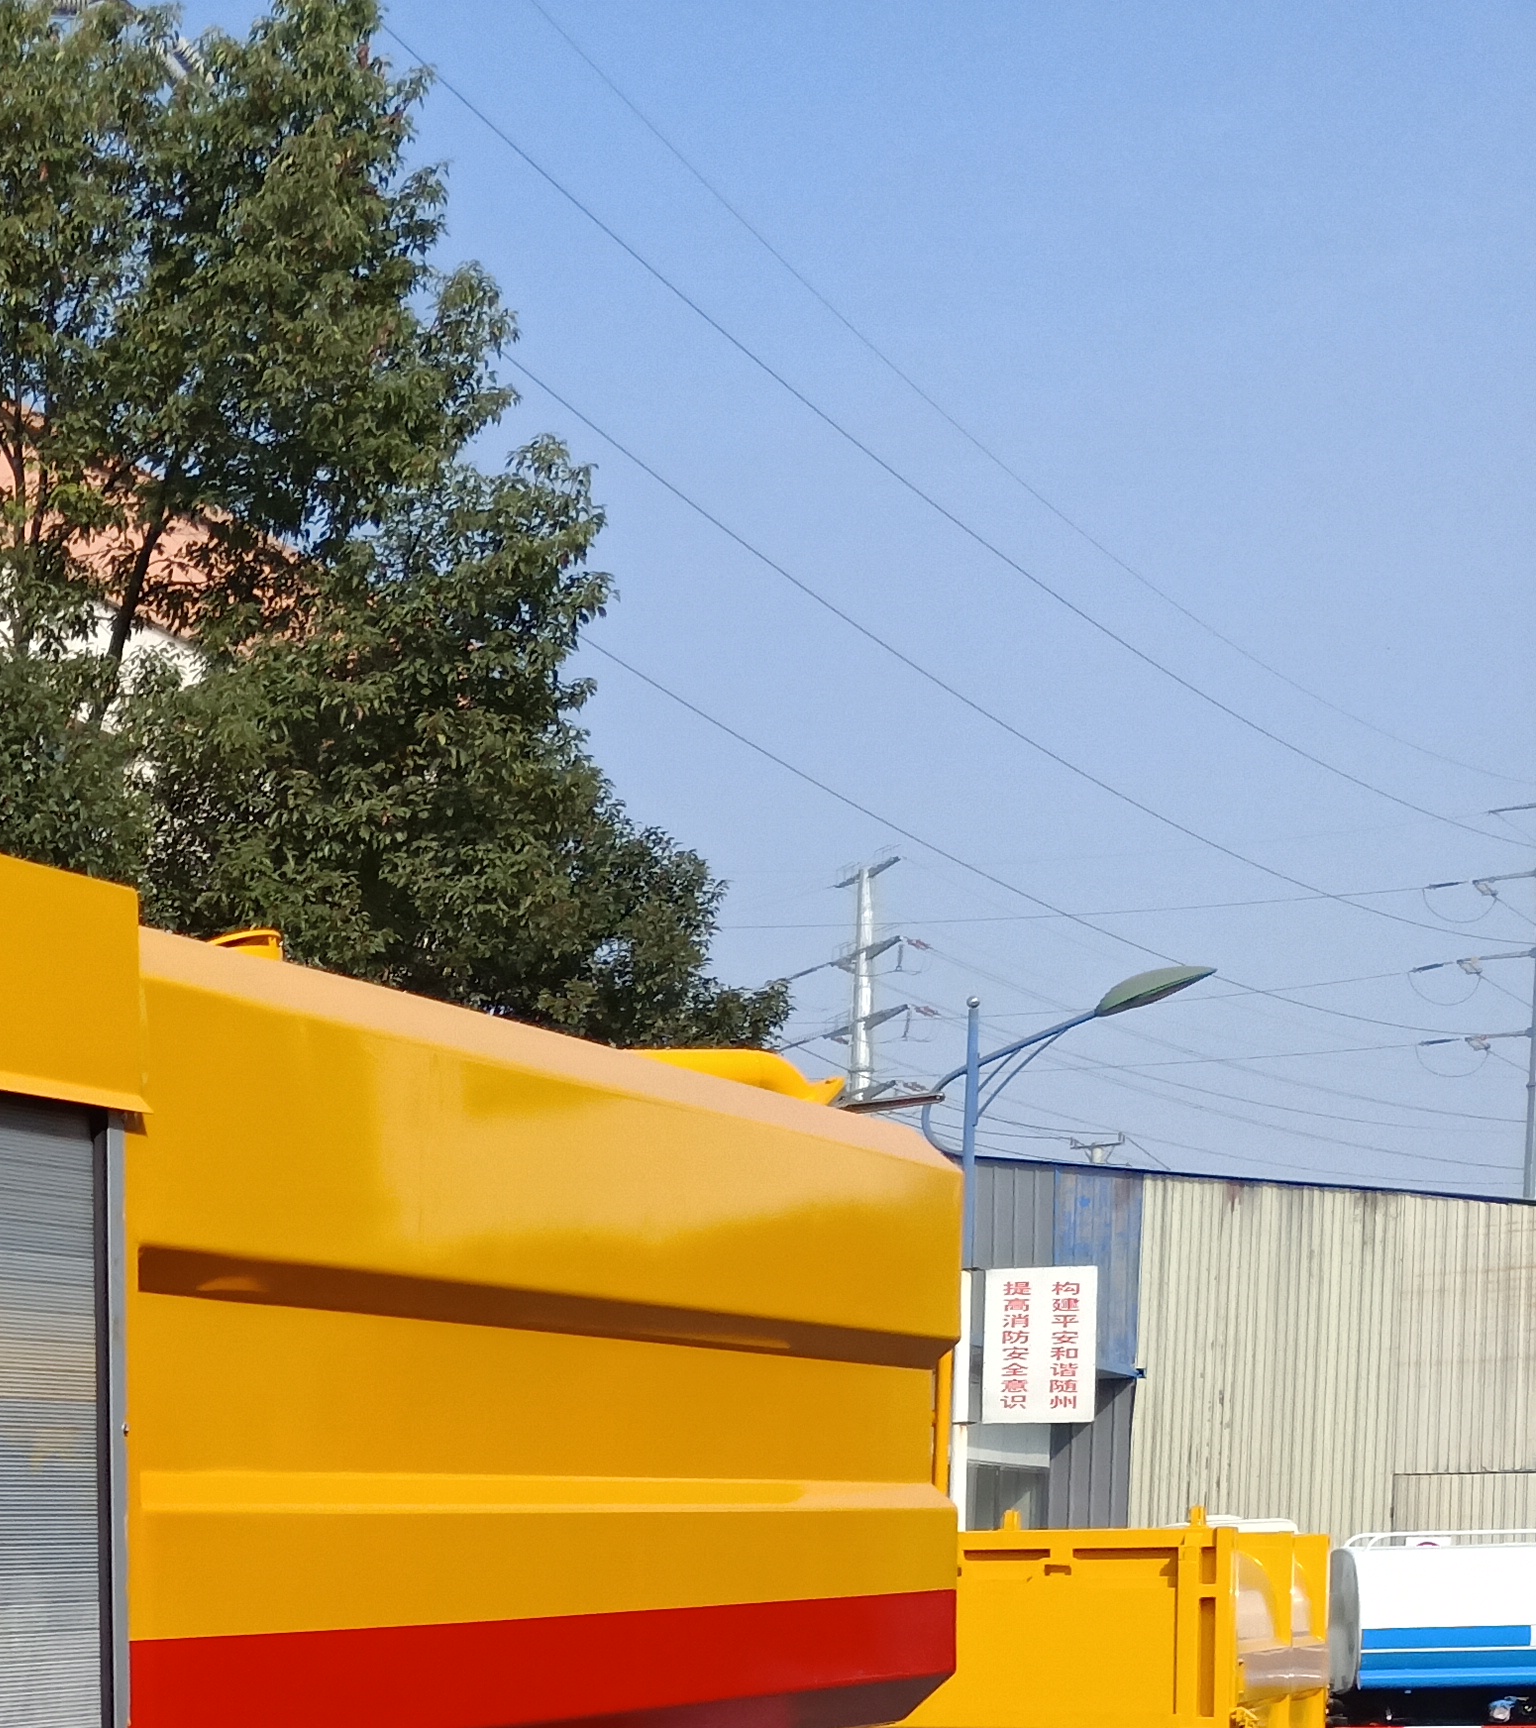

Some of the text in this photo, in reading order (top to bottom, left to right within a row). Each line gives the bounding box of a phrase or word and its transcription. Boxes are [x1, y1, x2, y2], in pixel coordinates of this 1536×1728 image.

[1000, 1281, 1031, 1410] 提高消防安全意识
[1049, 1281, 1080, 1410] 构建平安和谐随州
